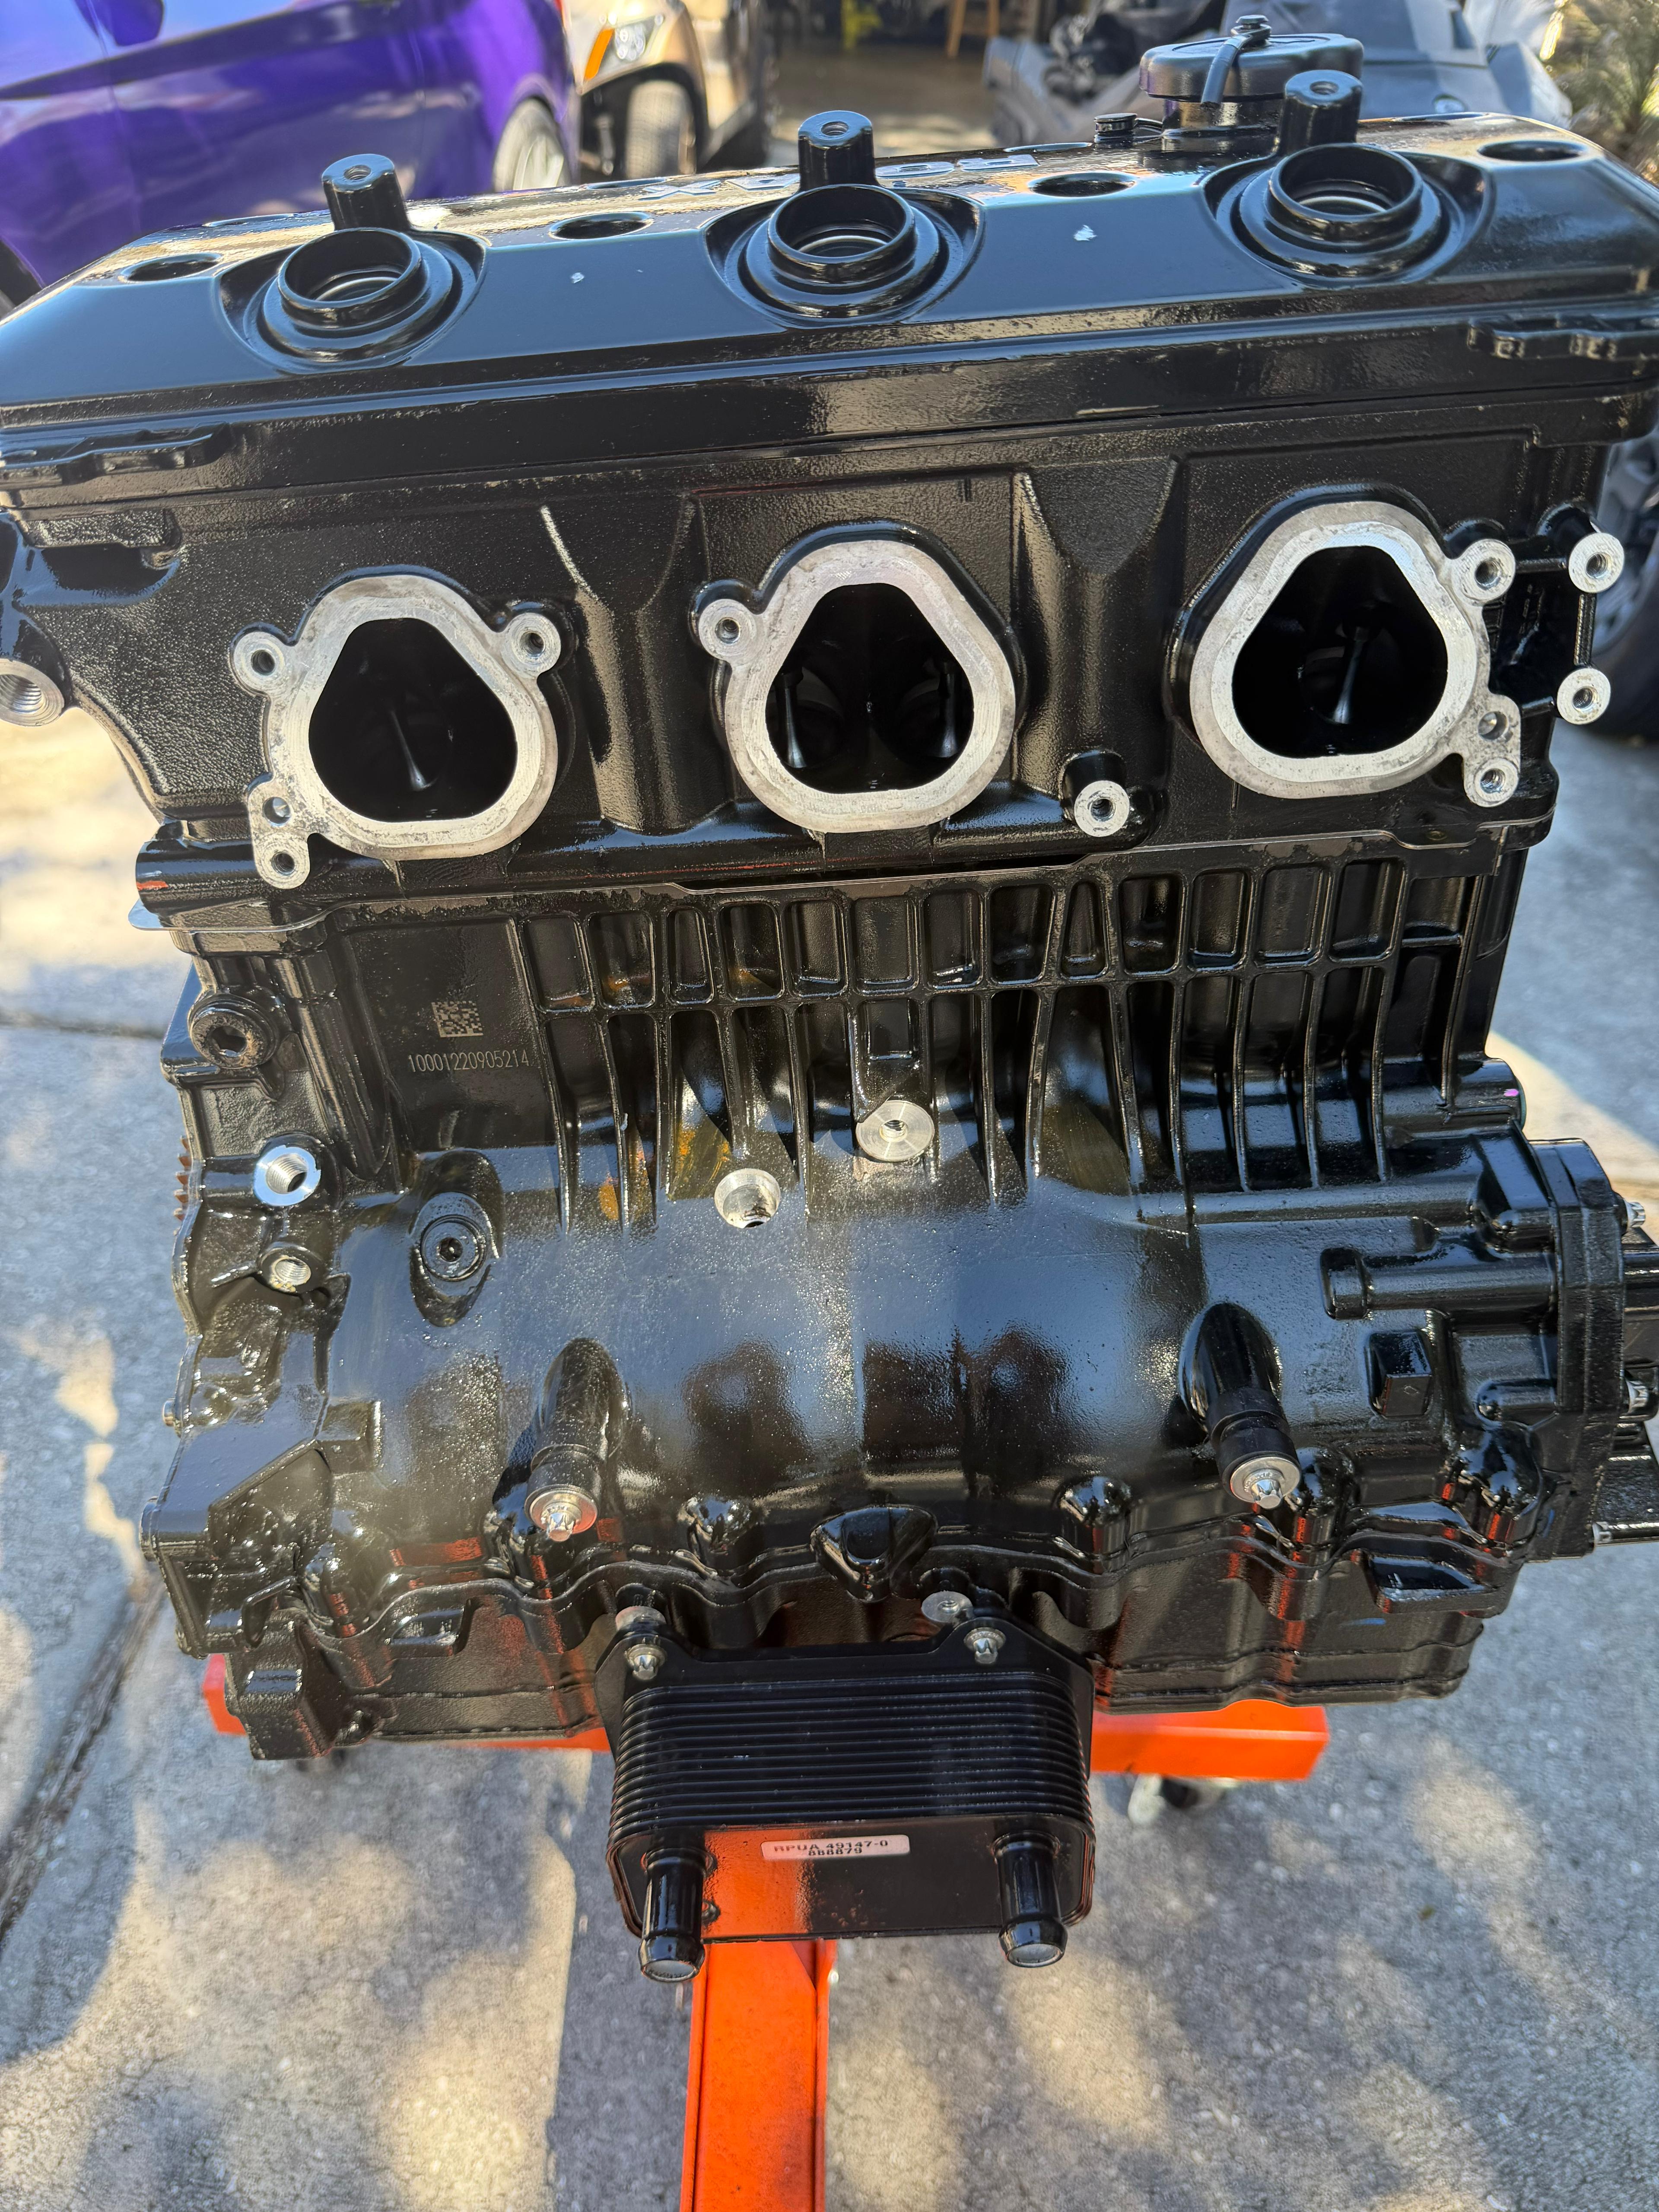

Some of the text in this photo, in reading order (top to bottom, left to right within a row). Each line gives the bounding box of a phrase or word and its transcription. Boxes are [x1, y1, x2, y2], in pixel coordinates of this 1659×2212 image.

[638, 154, 1039, 200] ROAX
[408, 1049, 529, 1072] 10001220905214
[774, 1840, 888, 1852] RPUA 49147-0
